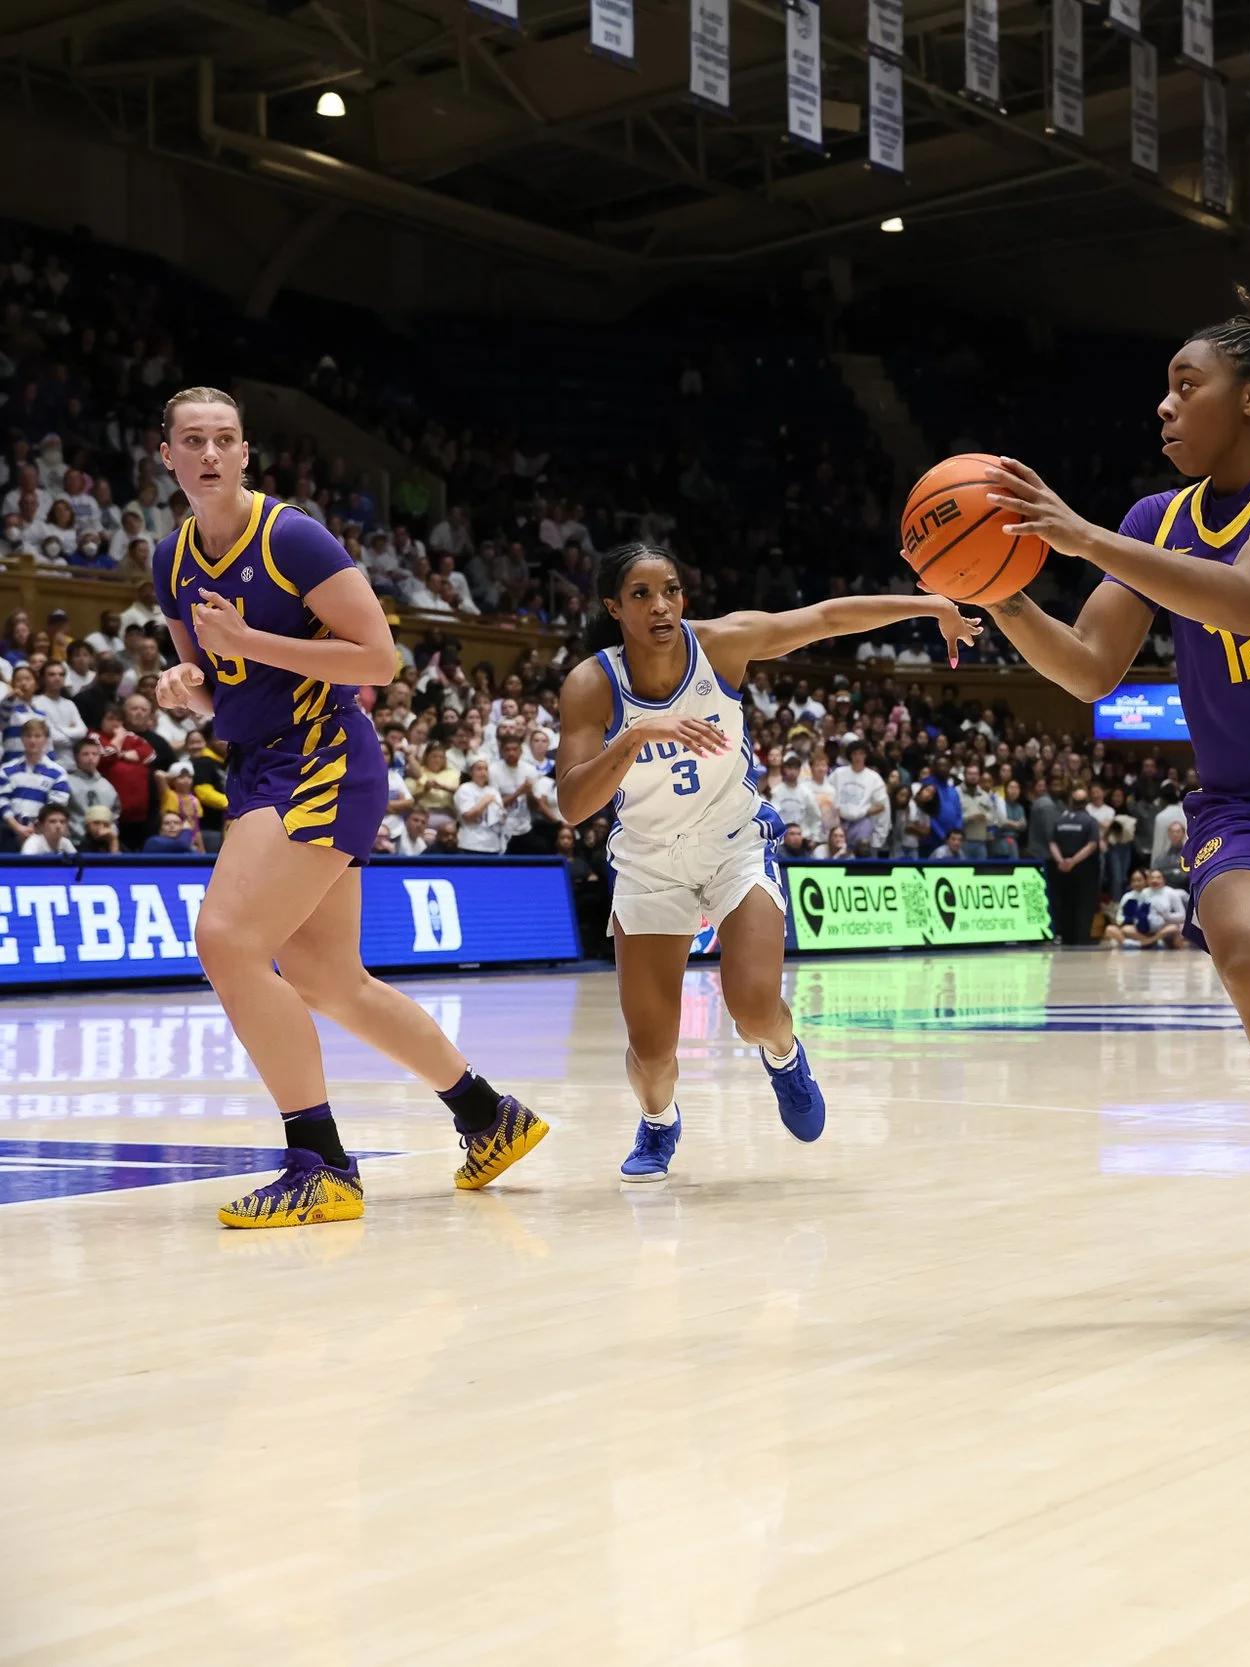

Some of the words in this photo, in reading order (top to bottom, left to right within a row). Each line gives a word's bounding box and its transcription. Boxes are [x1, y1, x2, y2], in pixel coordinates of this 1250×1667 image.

[636, 713, 721, 764] DU
[670, 759, 701, 796] 3
[826, 884, 899, 913] wave
[958, 883, 1020, 911] wave
[840, 919, 894, 937] rideshare
